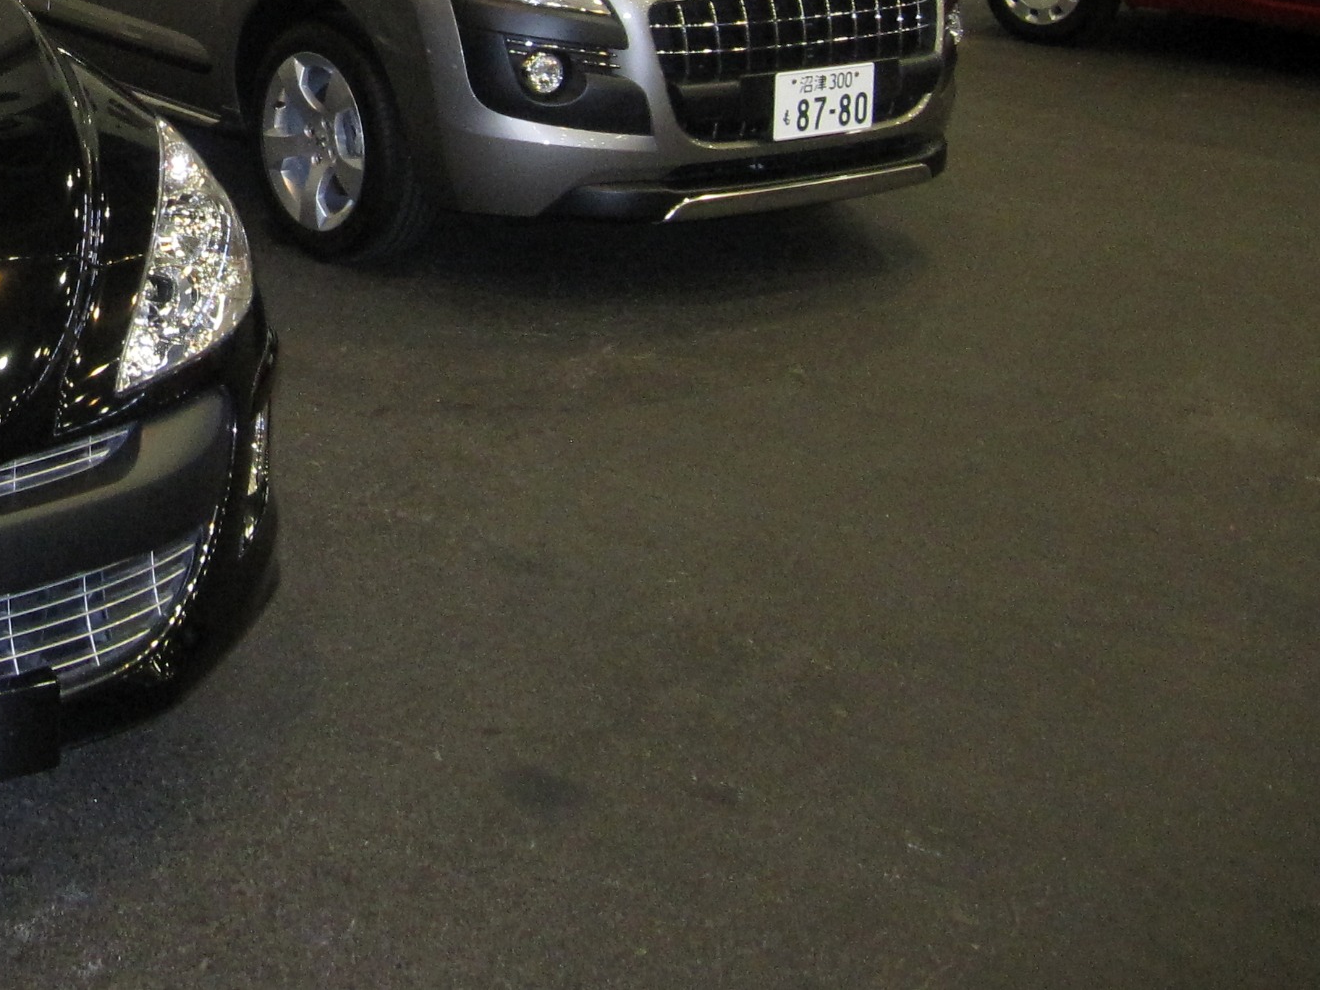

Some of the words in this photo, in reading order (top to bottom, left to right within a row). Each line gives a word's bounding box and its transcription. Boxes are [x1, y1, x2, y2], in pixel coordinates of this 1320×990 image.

[799, 74, 827, 93] 沼津
[828, 71, 853, 90] 300
[782, 109, 791, 126] も
[796, 91, 868, 132] 87-80
